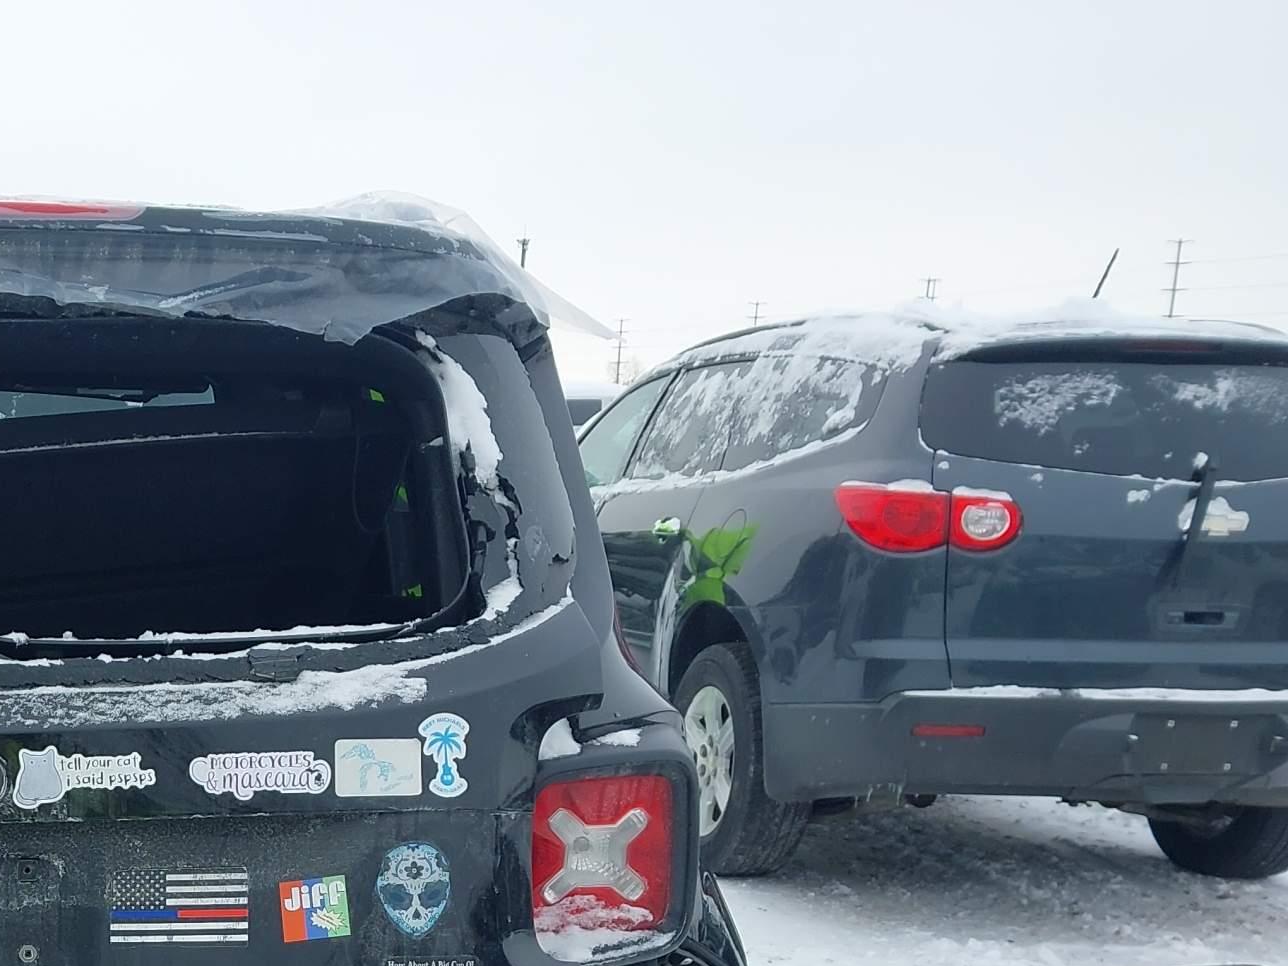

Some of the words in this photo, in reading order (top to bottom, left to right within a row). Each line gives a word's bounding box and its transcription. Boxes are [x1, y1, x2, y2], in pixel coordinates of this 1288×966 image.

[60, 757, 81, 771] tell
[85, 758, 113, 770] your
[116, 755, 139, 768] cat
[210, 753, 312, 770] MOTORCYCLES
[75, 771, 104, 785] said
[108, 772, 154, 787] pspsps
[222, 770, 313, 798] mascara
[283, 880, 345, 911] Jiff
